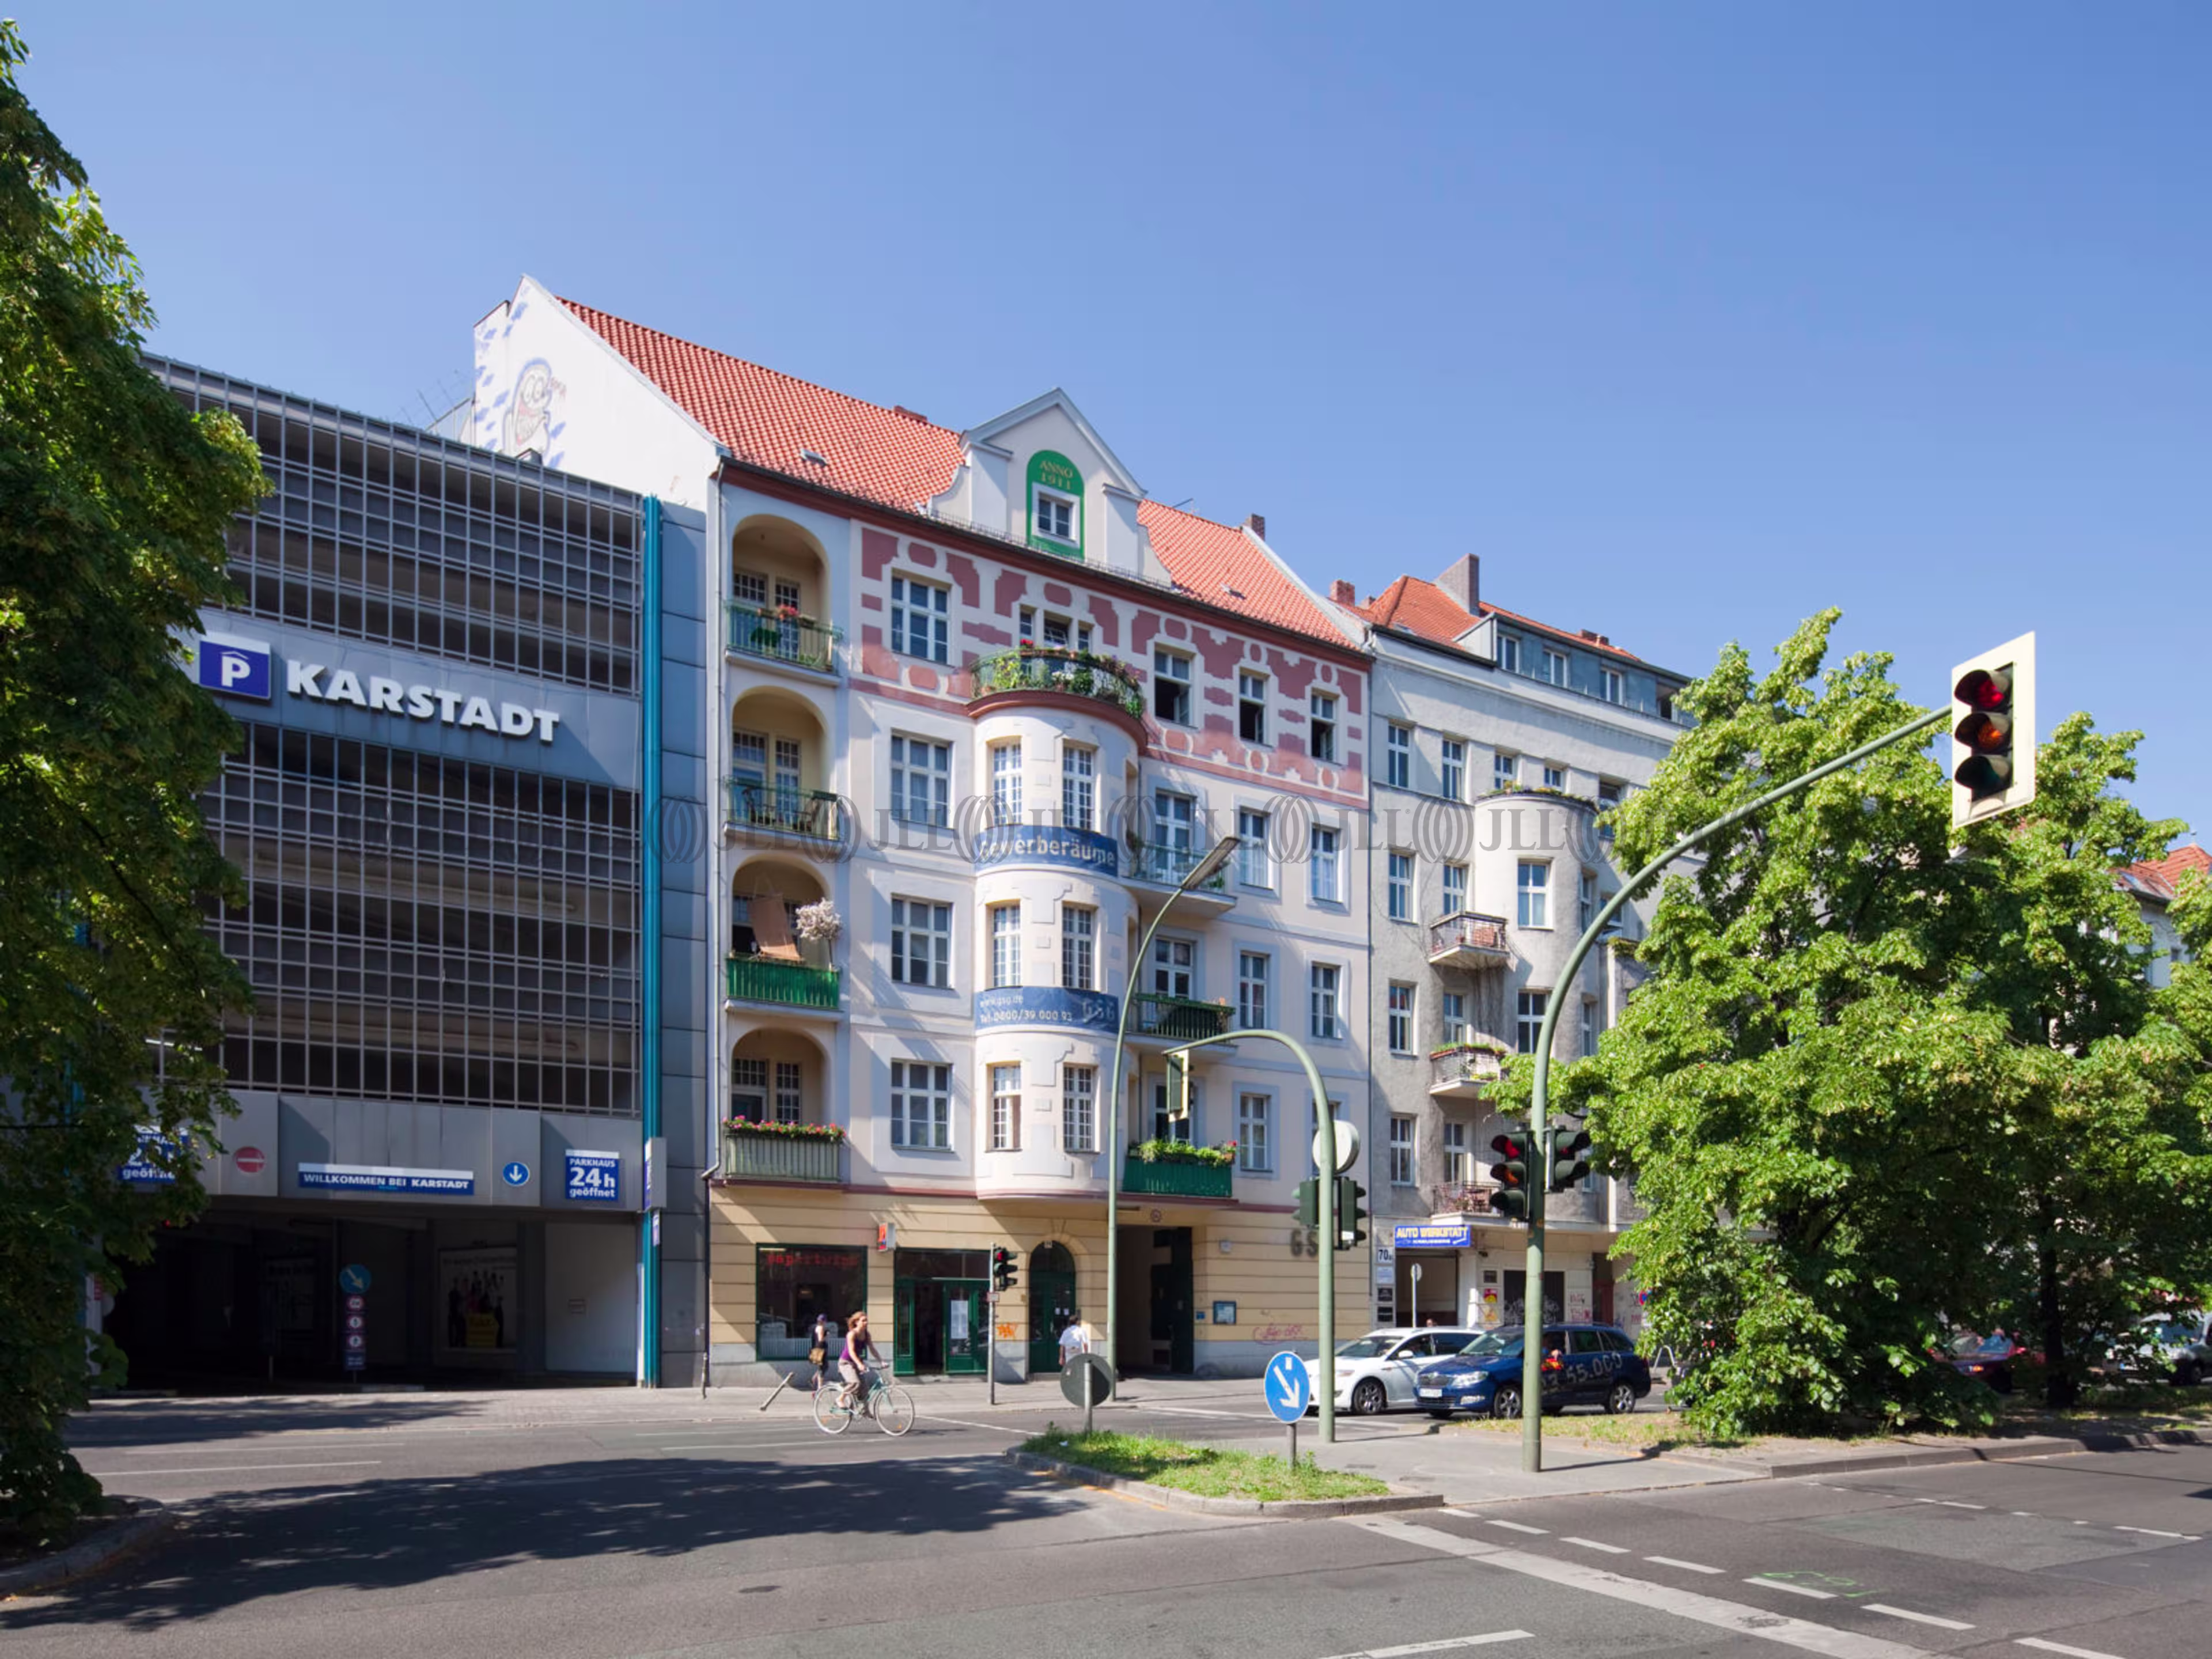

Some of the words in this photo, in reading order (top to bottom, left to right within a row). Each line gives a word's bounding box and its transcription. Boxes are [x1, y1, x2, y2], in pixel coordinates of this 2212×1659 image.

[1039, 460, 1073, 479] ANNO
[222, 655, 251, 688] P
[286, 658, 560, 743] KARSTADT
[569, 1158, 616, 1168] PARKHAUS
[304, 1173, 385, 1186] WILLKOMMEN
[388, 1178, 406, 1187] BEI
[411, 1179, 469, 1189] KARSTADT
[569, 1167, 602, 1187] 24
[569, 1187, 615, 1198] geöffnet
[1396, 1227, 1418, 1238] AUTO
[1419, 1226, 1468, 1238] WERKSTATT
